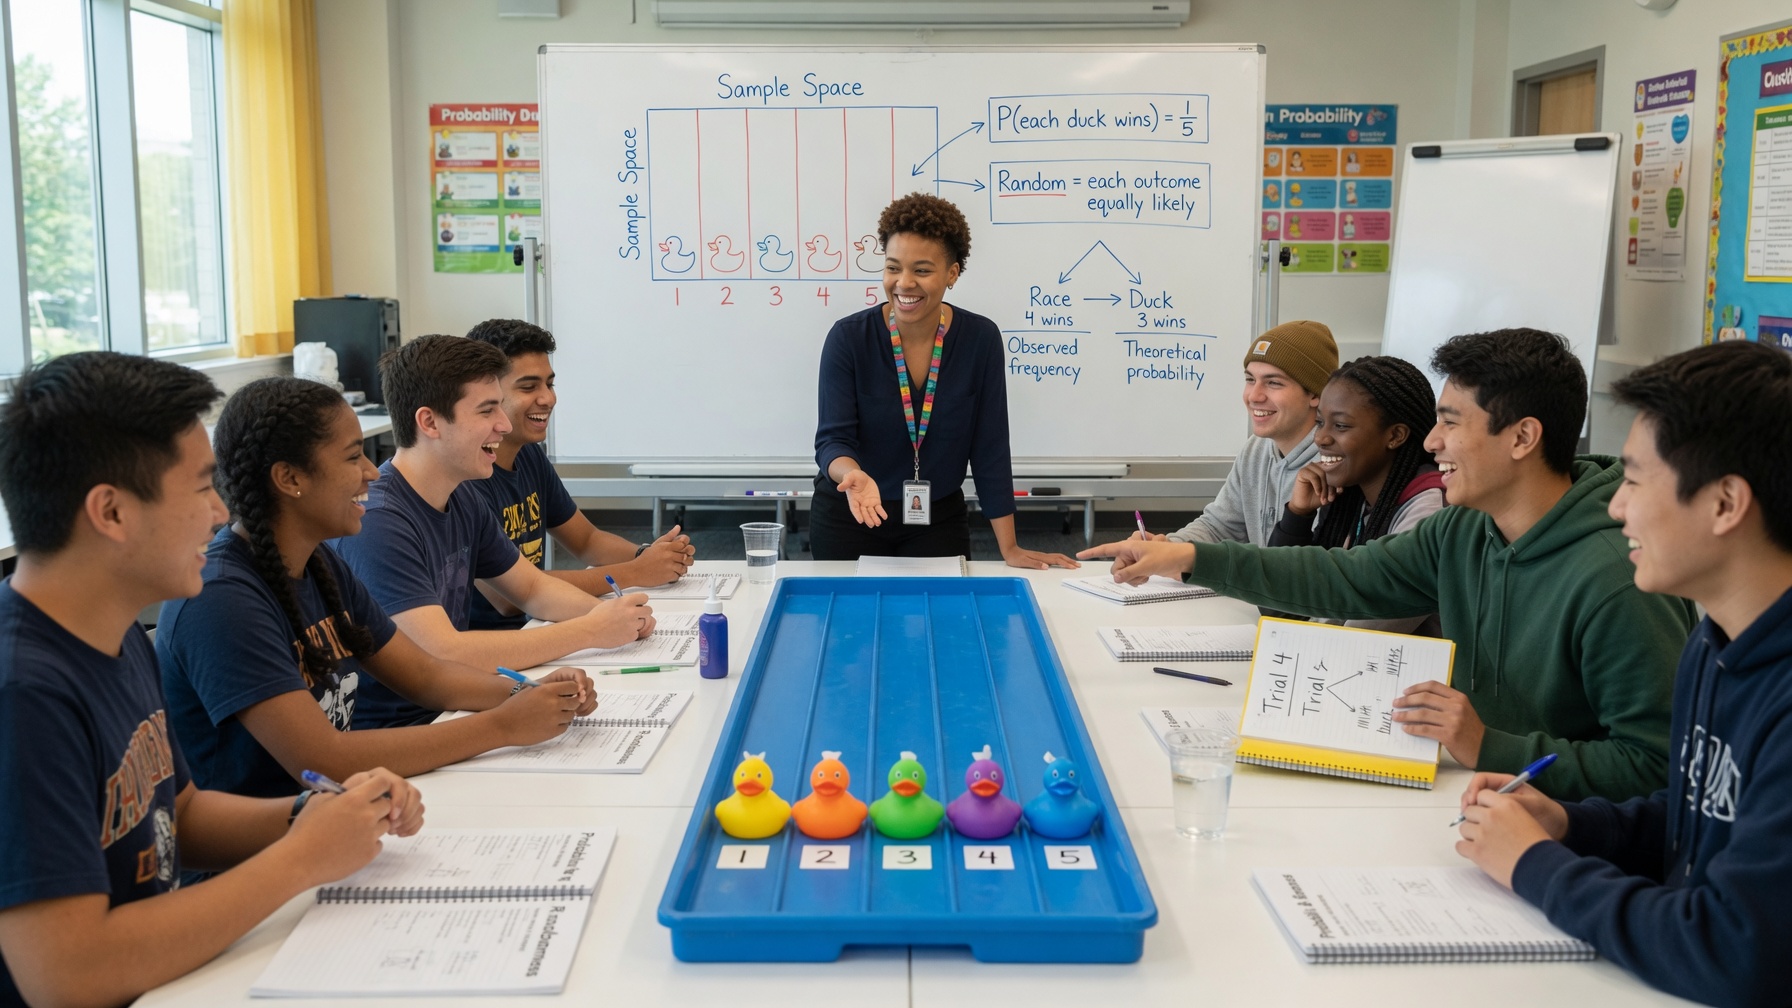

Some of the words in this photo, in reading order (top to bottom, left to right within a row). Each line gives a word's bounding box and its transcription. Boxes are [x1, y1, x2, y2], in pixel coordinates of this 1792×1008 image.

[717, 73, 791, 105] Sample
[803, 73, 865, 104] Space
[441, 107, 516, 125] Probability
[997, 105, 1059, 134] P(each
[1067, 109, 1107, 128] duck
[1114, 103, 1159, 133] wins)
[1280, 107, 1363, 126] Probability
[618, 127, 645, 184] Space
[998, 169, 1067, 192] Random
[1087, 171, 1127, 189] each
[1133, 170, 1202, 190] outcome
[1087, 192, 1144, 219] equally
[1152, 192, 1196, 221] likely
[619, 194, 646, 261] Sample
[675, 287, 680, 306] 1
[720, 286, 735, 306] 2
[769, 286, 784, 306] 3
[816, 286, 831, 307] 4
[865, 286, 878, 306] 5
[1029, 286, 1073, 308] Race
[1129, 289, 1174, 309] Duck
[1025, 311, 1034, 326] 4
[1041, 313, 1074, 327] wins
[1137, 312, 1148, 328] 3
[1153, 315, 1187, 329] wins
[1007, 336, 1078, 356] Observed
[1123, 339, 1207, 362] Theoretical
[1008, 357, 1081, 385] frequency
[1127, 364, 1205, 391] probability
[1272, 651, 1293, 665] 4
[1262, 672, 1288, 714] Trial
[1302, 676, 1325, 716] Trial
[739, 849, 747, 864] 1
[815, 849, 836, 864] 2
[897, 849, 918, 865] 3
[977, 850, 998, 865] 4
[1059, 850, 1081, 865] 5
